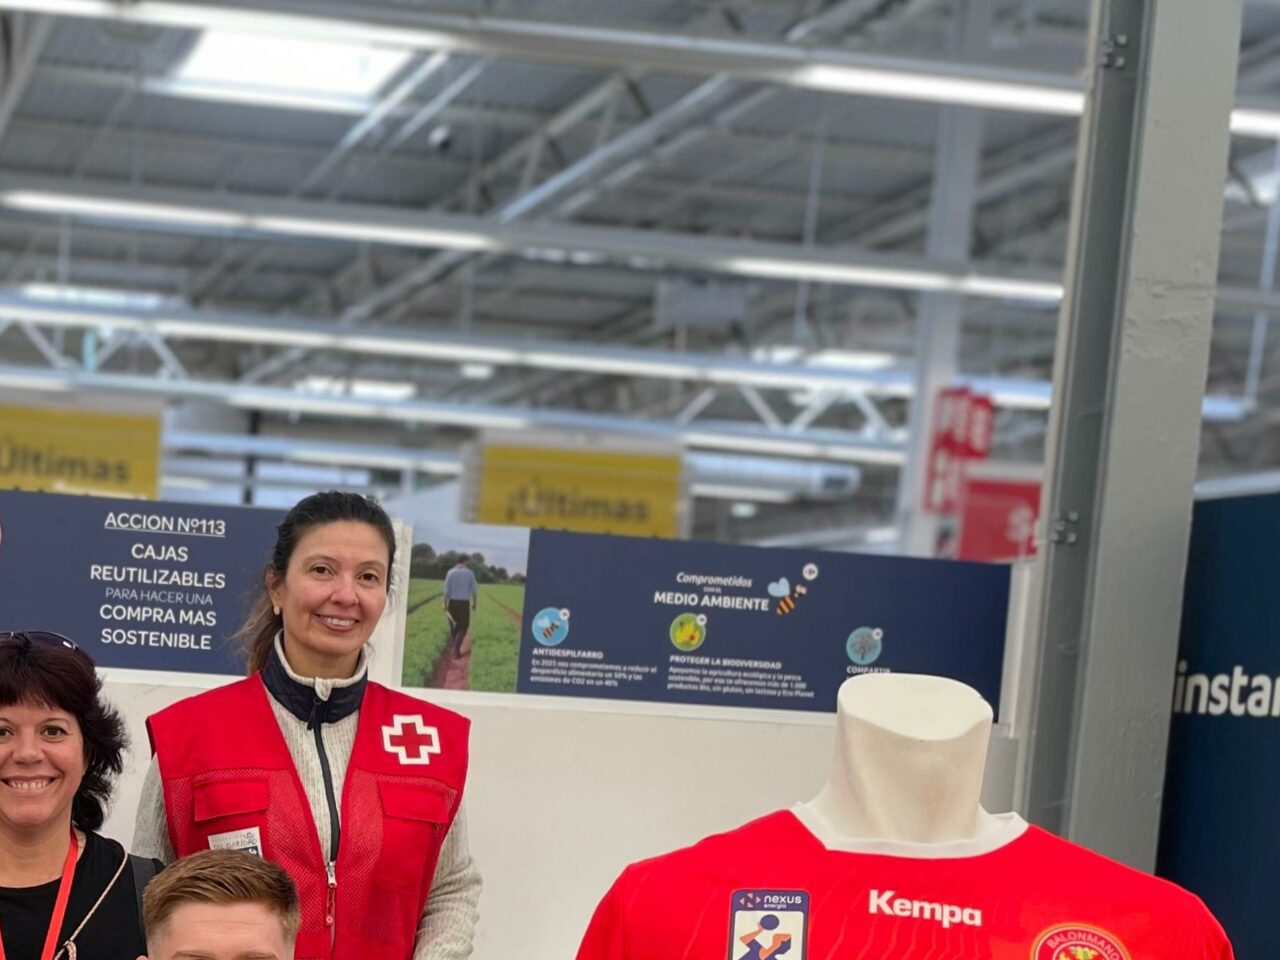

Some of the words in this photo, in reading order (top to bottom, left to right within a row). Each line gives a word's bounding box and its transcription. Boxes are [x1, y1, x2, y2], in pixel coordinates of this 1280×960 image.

[104, 512, 174, 532] ACCION
[130, 543, 189, 562] CAJAS
[90, 564, 227, 589] REUTILIZABLES
[676, 571, 753, 588] Comprometidos
[105, 587, 139, 600] PARA
[140, 589, 184, 604] HACER
[185, 593, 214, 606] UNA
[653, 591, 699, 606] MEDIO
[700, 595, 770, 611] AMBIENTE
[99, 604, 176, 625] COMPRA
[179, 609, 217, 627] MAS
[101, 628, 212, 650] SOSTENIBLE
[532, 647, 604, 660] ANTIDESPILFARRO
[669, 655, 710, 666] PROTEGER
[711, 658, 721, 666] LA
[763, 894, 802, 904] nexus
[868, 887, 983, 928] Kempa
